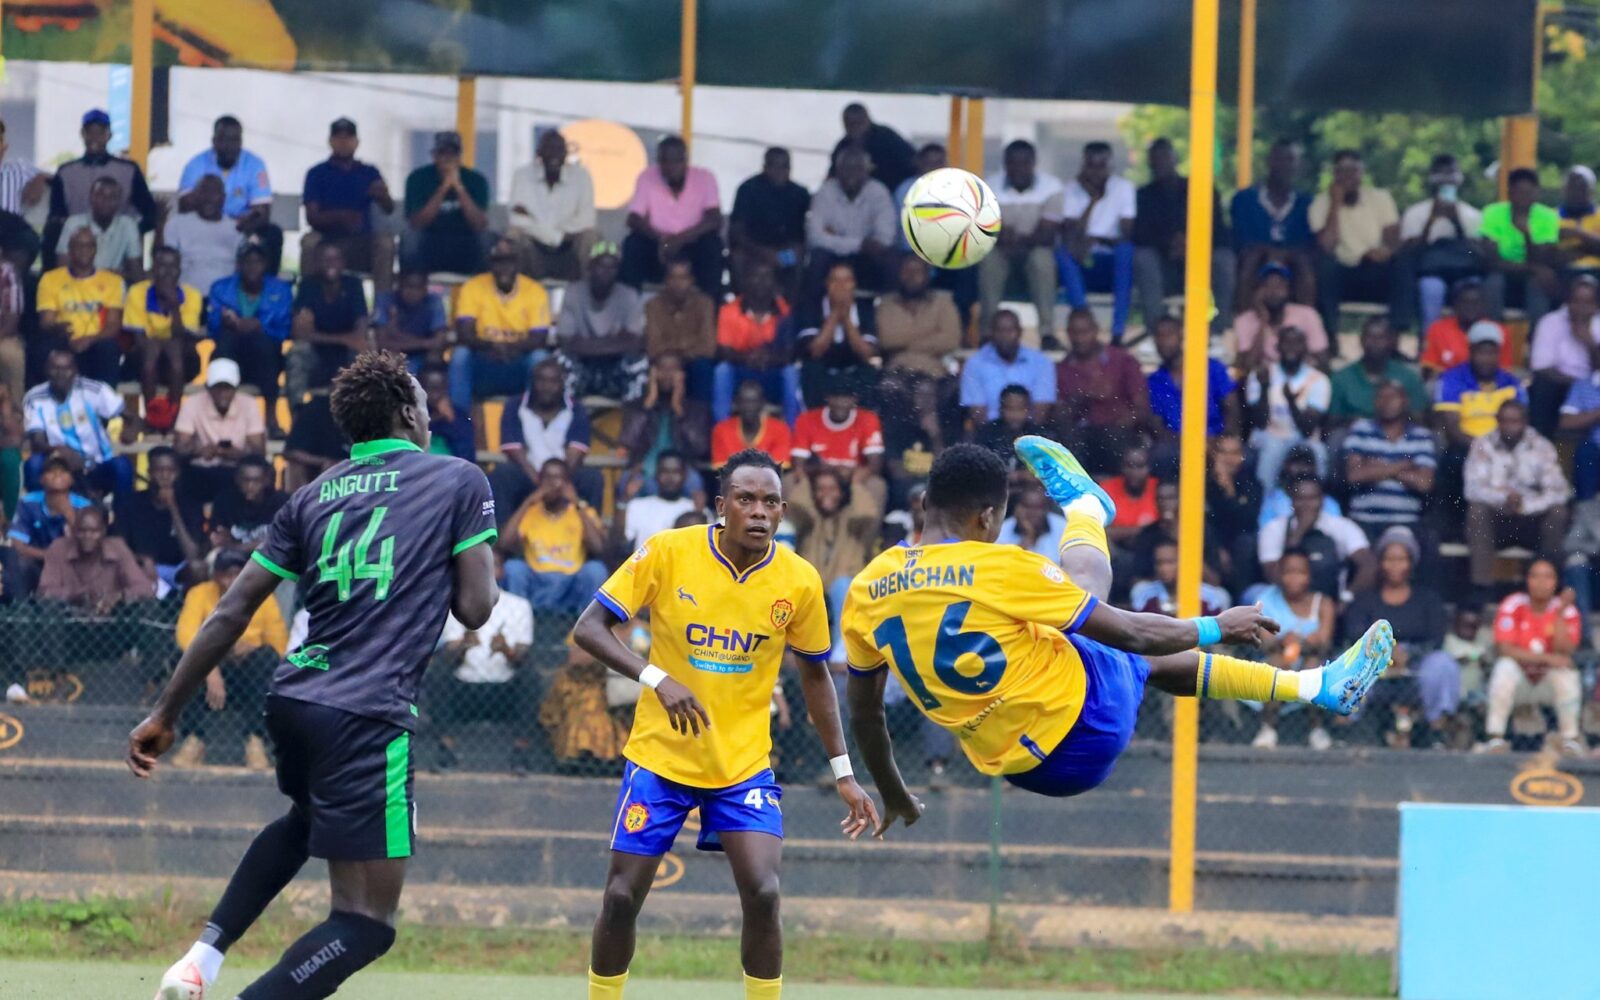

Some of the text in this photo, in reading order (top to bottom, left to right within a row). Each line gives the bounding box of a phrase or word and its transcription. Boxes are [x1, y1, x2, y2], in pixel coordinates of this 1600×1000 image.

[319, 470, 400, 503] ANGUTI
[316, 506, 395, 602] 44
[873, 600, 1007, 711] 16
[743, 788, 763, 809] 4
[290, 945, 335, 984] LUGAZI
